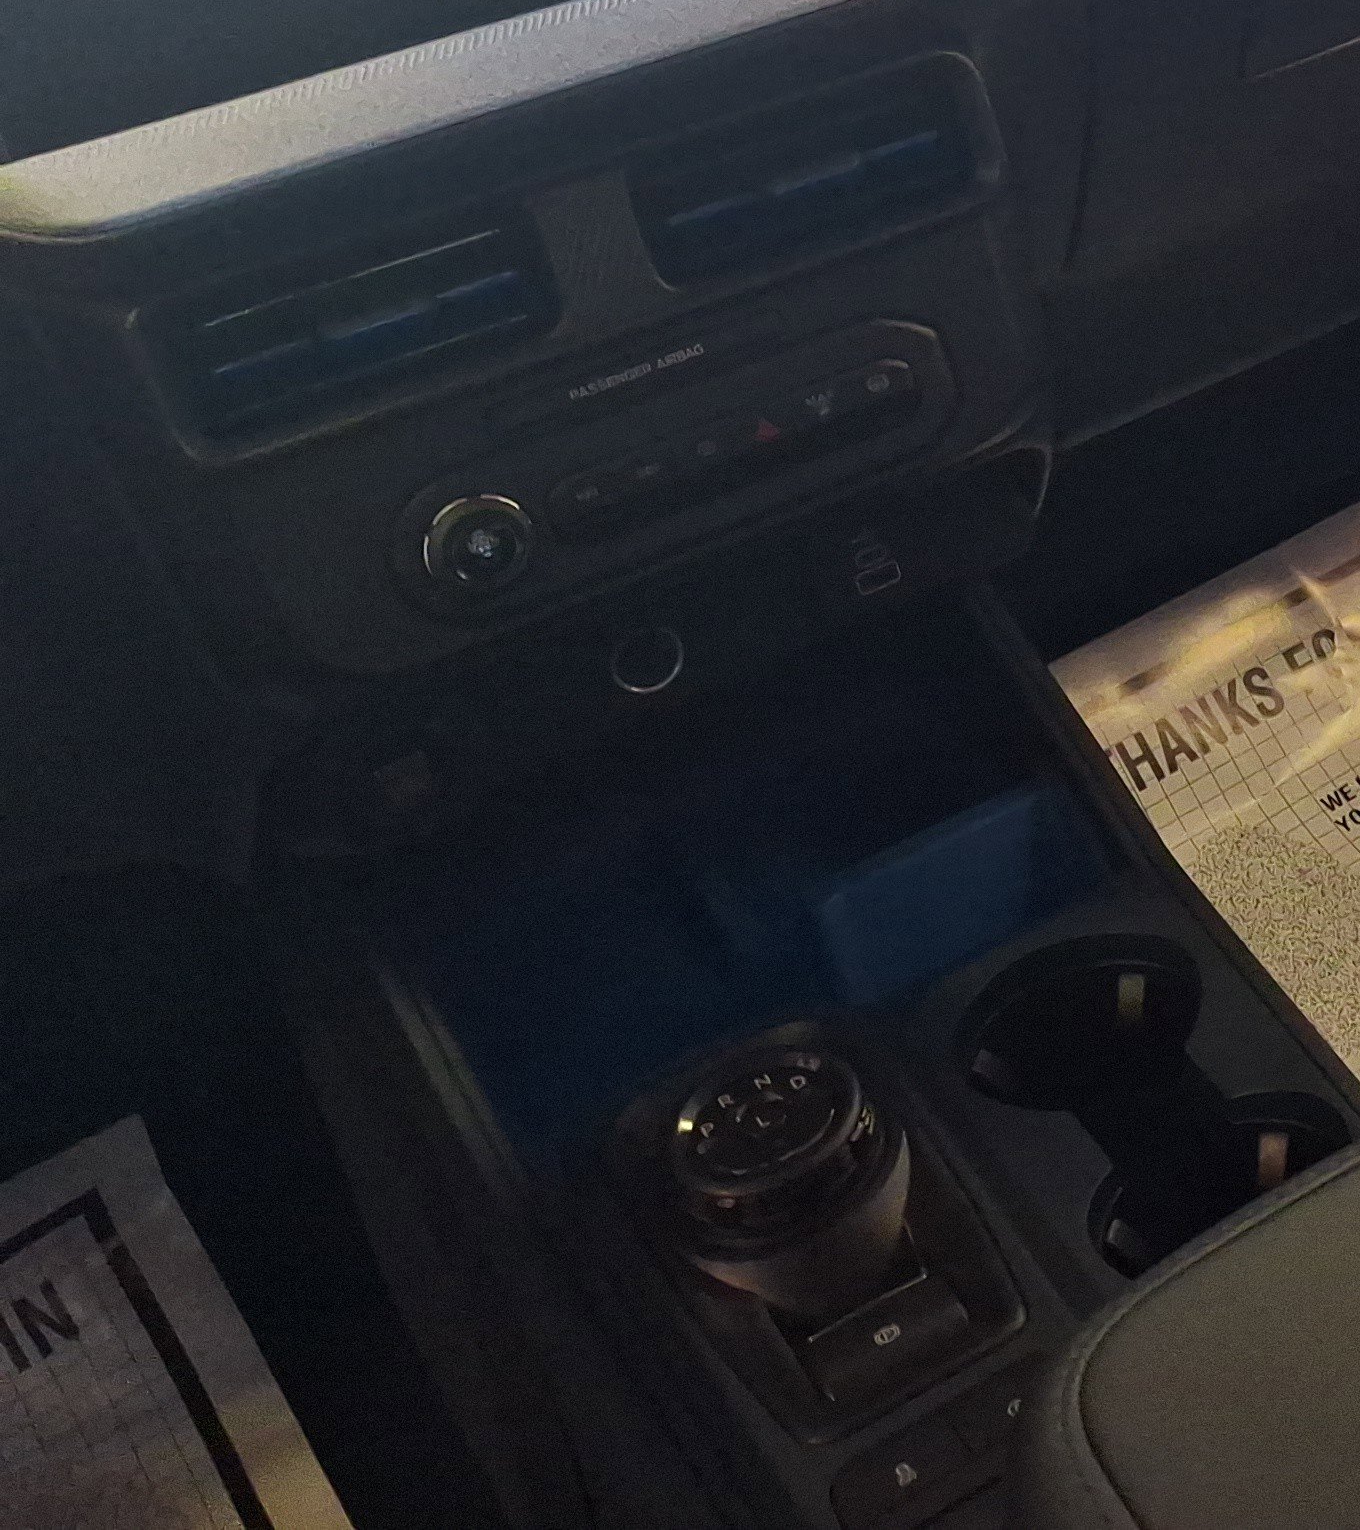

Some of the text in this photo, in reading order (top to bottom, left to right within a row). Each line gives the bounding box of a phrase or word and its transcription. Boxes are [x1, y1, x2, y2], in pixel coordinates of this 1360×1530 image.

[657, 343, 704, 369] AIRBAG
[1105, 666, 1285, 792] HANKS
[1320, 782, 1358, 812] WE
[753, 1074, 772, 1090] N
[789, 1075, 807, 1090] D
[0, 1277, 81, 1373] IN
